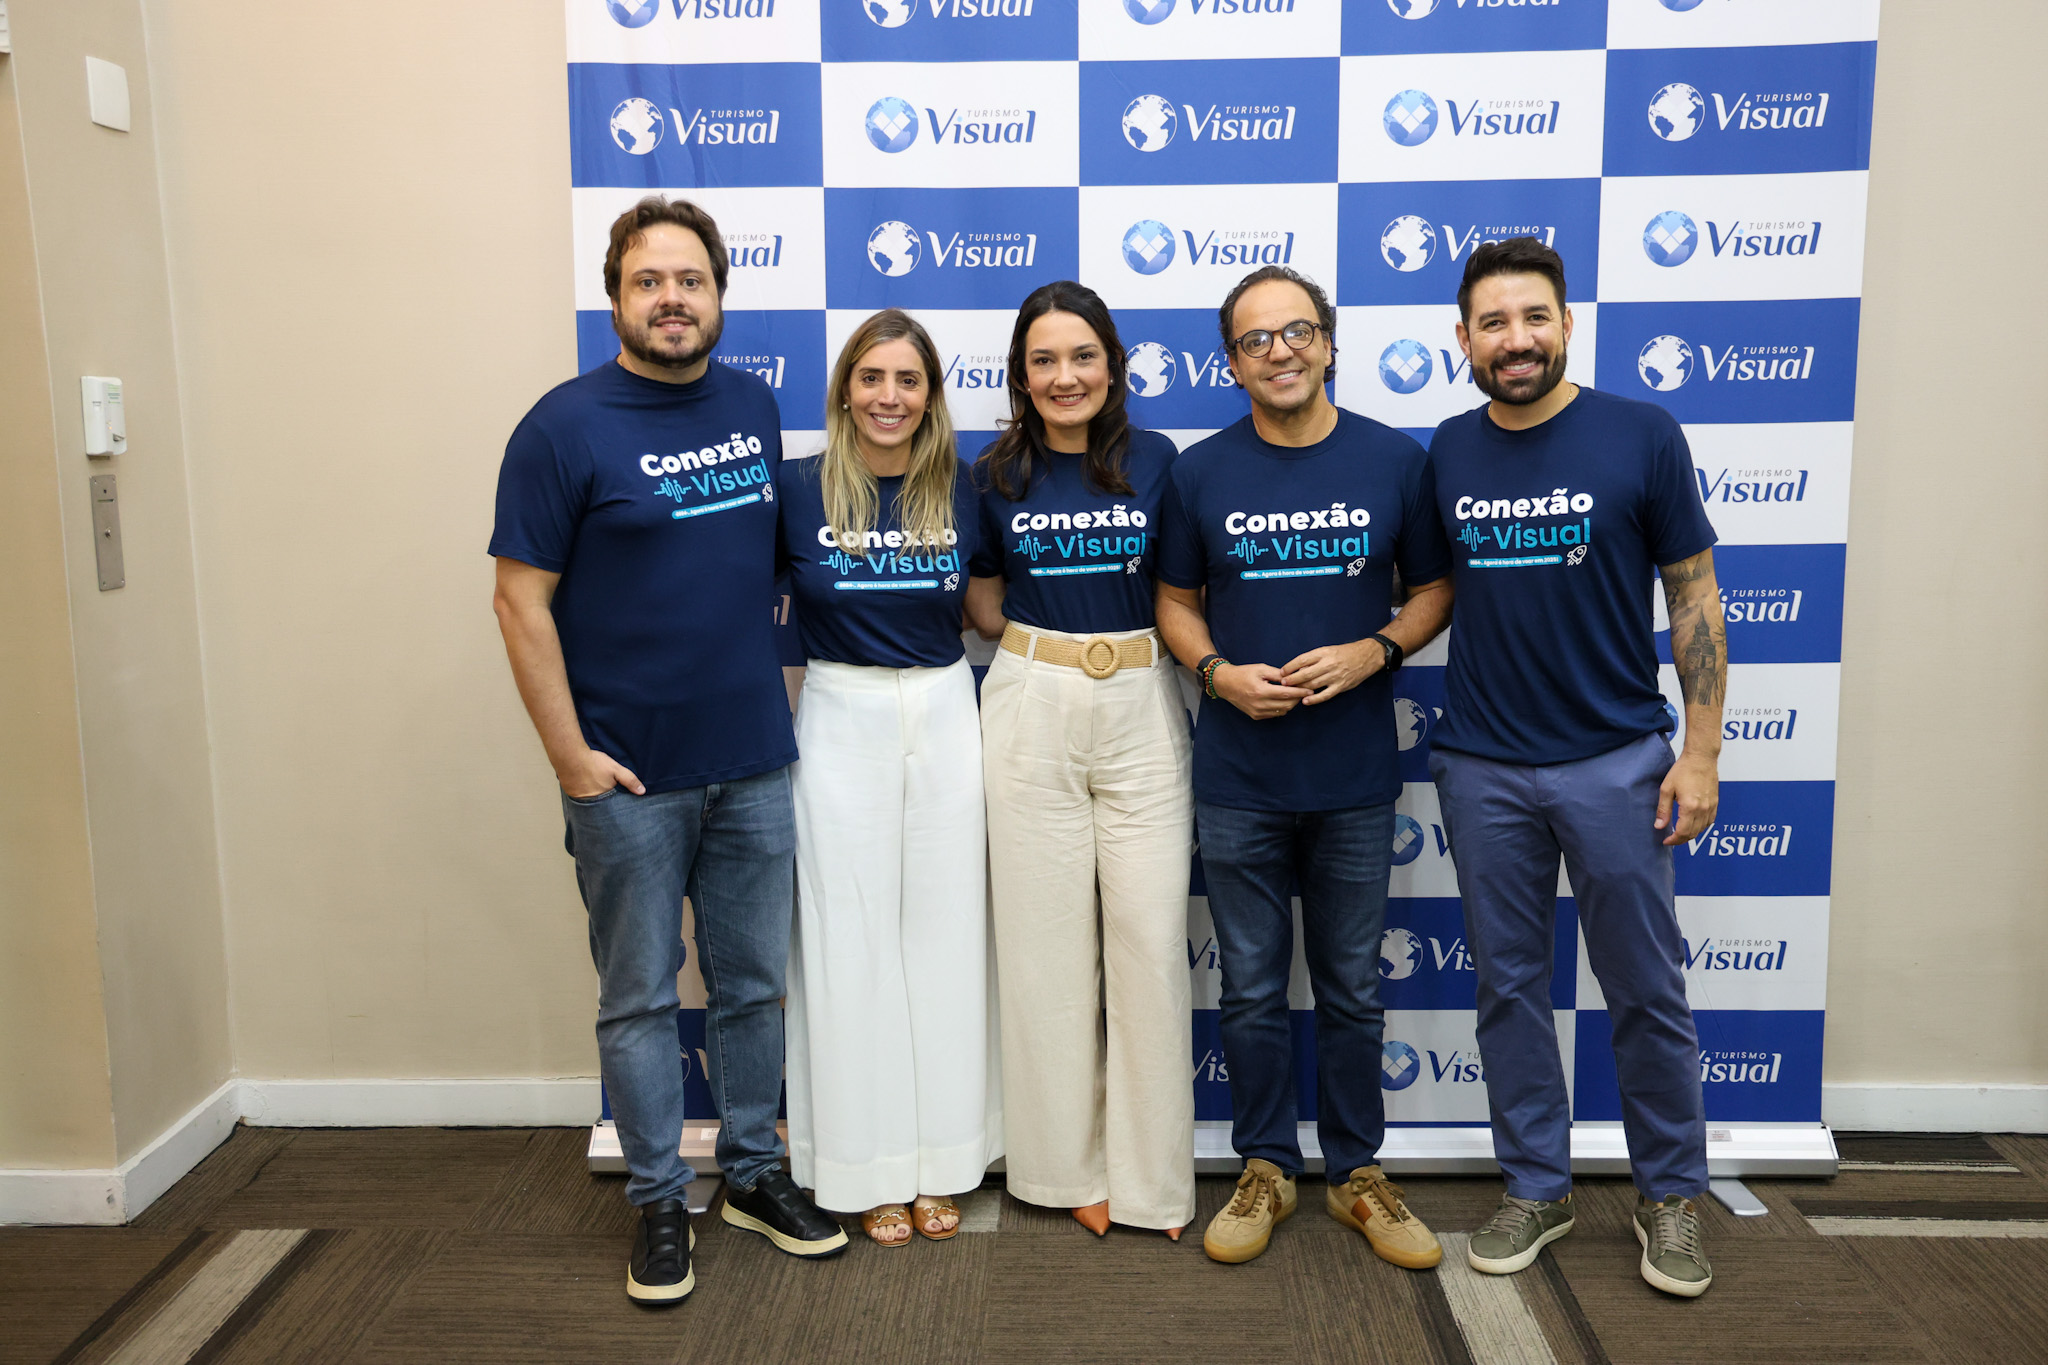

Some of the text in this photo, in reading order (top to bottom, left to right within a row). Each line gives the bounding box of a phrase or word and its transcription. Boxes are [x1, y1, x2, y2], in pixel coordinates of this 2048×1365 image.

[1225, 105, 1280, 114] TURISMO
[1489, 99, 1544, 109] TURISMO
[1711, 92, 1829, 131] Visual
[1755, 92, 1812, 103] TURISMO
[669, 108, 780, 145] Visual
[711, 110, 764, 118] TURISMO
[924, 108, 1036, 145] Visual
[967, 109, 1020, 118] TURISMO
[1182, 104, 1296, 142] Visual
[1445, 99, 1560, 136] Visual
[721, 234, 767, 242] URISMO
[968, 233, 1021, 242] TURISMO
[1224, 231, 1278, 239] TURISMO
[1484, 225, 1540, 234] TURISMO
[1705, 220, 1822, 257] Visual
[1749, 221, 1805, 230] TURISMO
[728, 235, 782, 267] ual
[926, 231, 1037, 268] Visual
[1182, 229, 1294, 266] Visual
[717, 355, 770, 364] TURISMO
[970, 355, 1010, 363] TURIS
[1699, 344, 1815, 382] Visual
[1743, 345, 1798, 355] TURISMO
[1181, 351, 1236, 388] Vis
[640, 432, 762, 477] Conexão
[690, 458, 770, 497] Visual
[1694, 467, 1808, 503] Visual
[1738, 469, 1792, 477] TURISMO
[1011, 504, 1148, 533] Conexão
[1225, 502, 1371, 536] Conexão
[1455, 488, 1594, 521] Conexão
[1054, 532, 1146, 559] Visual
[1271, 531, 1370, 561] Visual
[1492, 517, 1591, 550] Visual
[866, 549, 960, 574] Visual
[1717, 588, 1803, 622] isual
[1732, 588, 1786, 597] TURISMO
[1722, 709, 1797, 740] sual
[1728, 708, 1781, 716] TURISMO
[1687, 822, 1792, 857] Visual
[1723, 824, 1776, 833] TURISMO
[1681, 937, 1787, 971] Visual
[1719, 939, 1772, 947] TURISMO
[1427, 1050, 1486, 1083] Vis
[1699, 1050, 1782, 1083] isual
[1714, 1051, 1767, 1060] TURISMO
